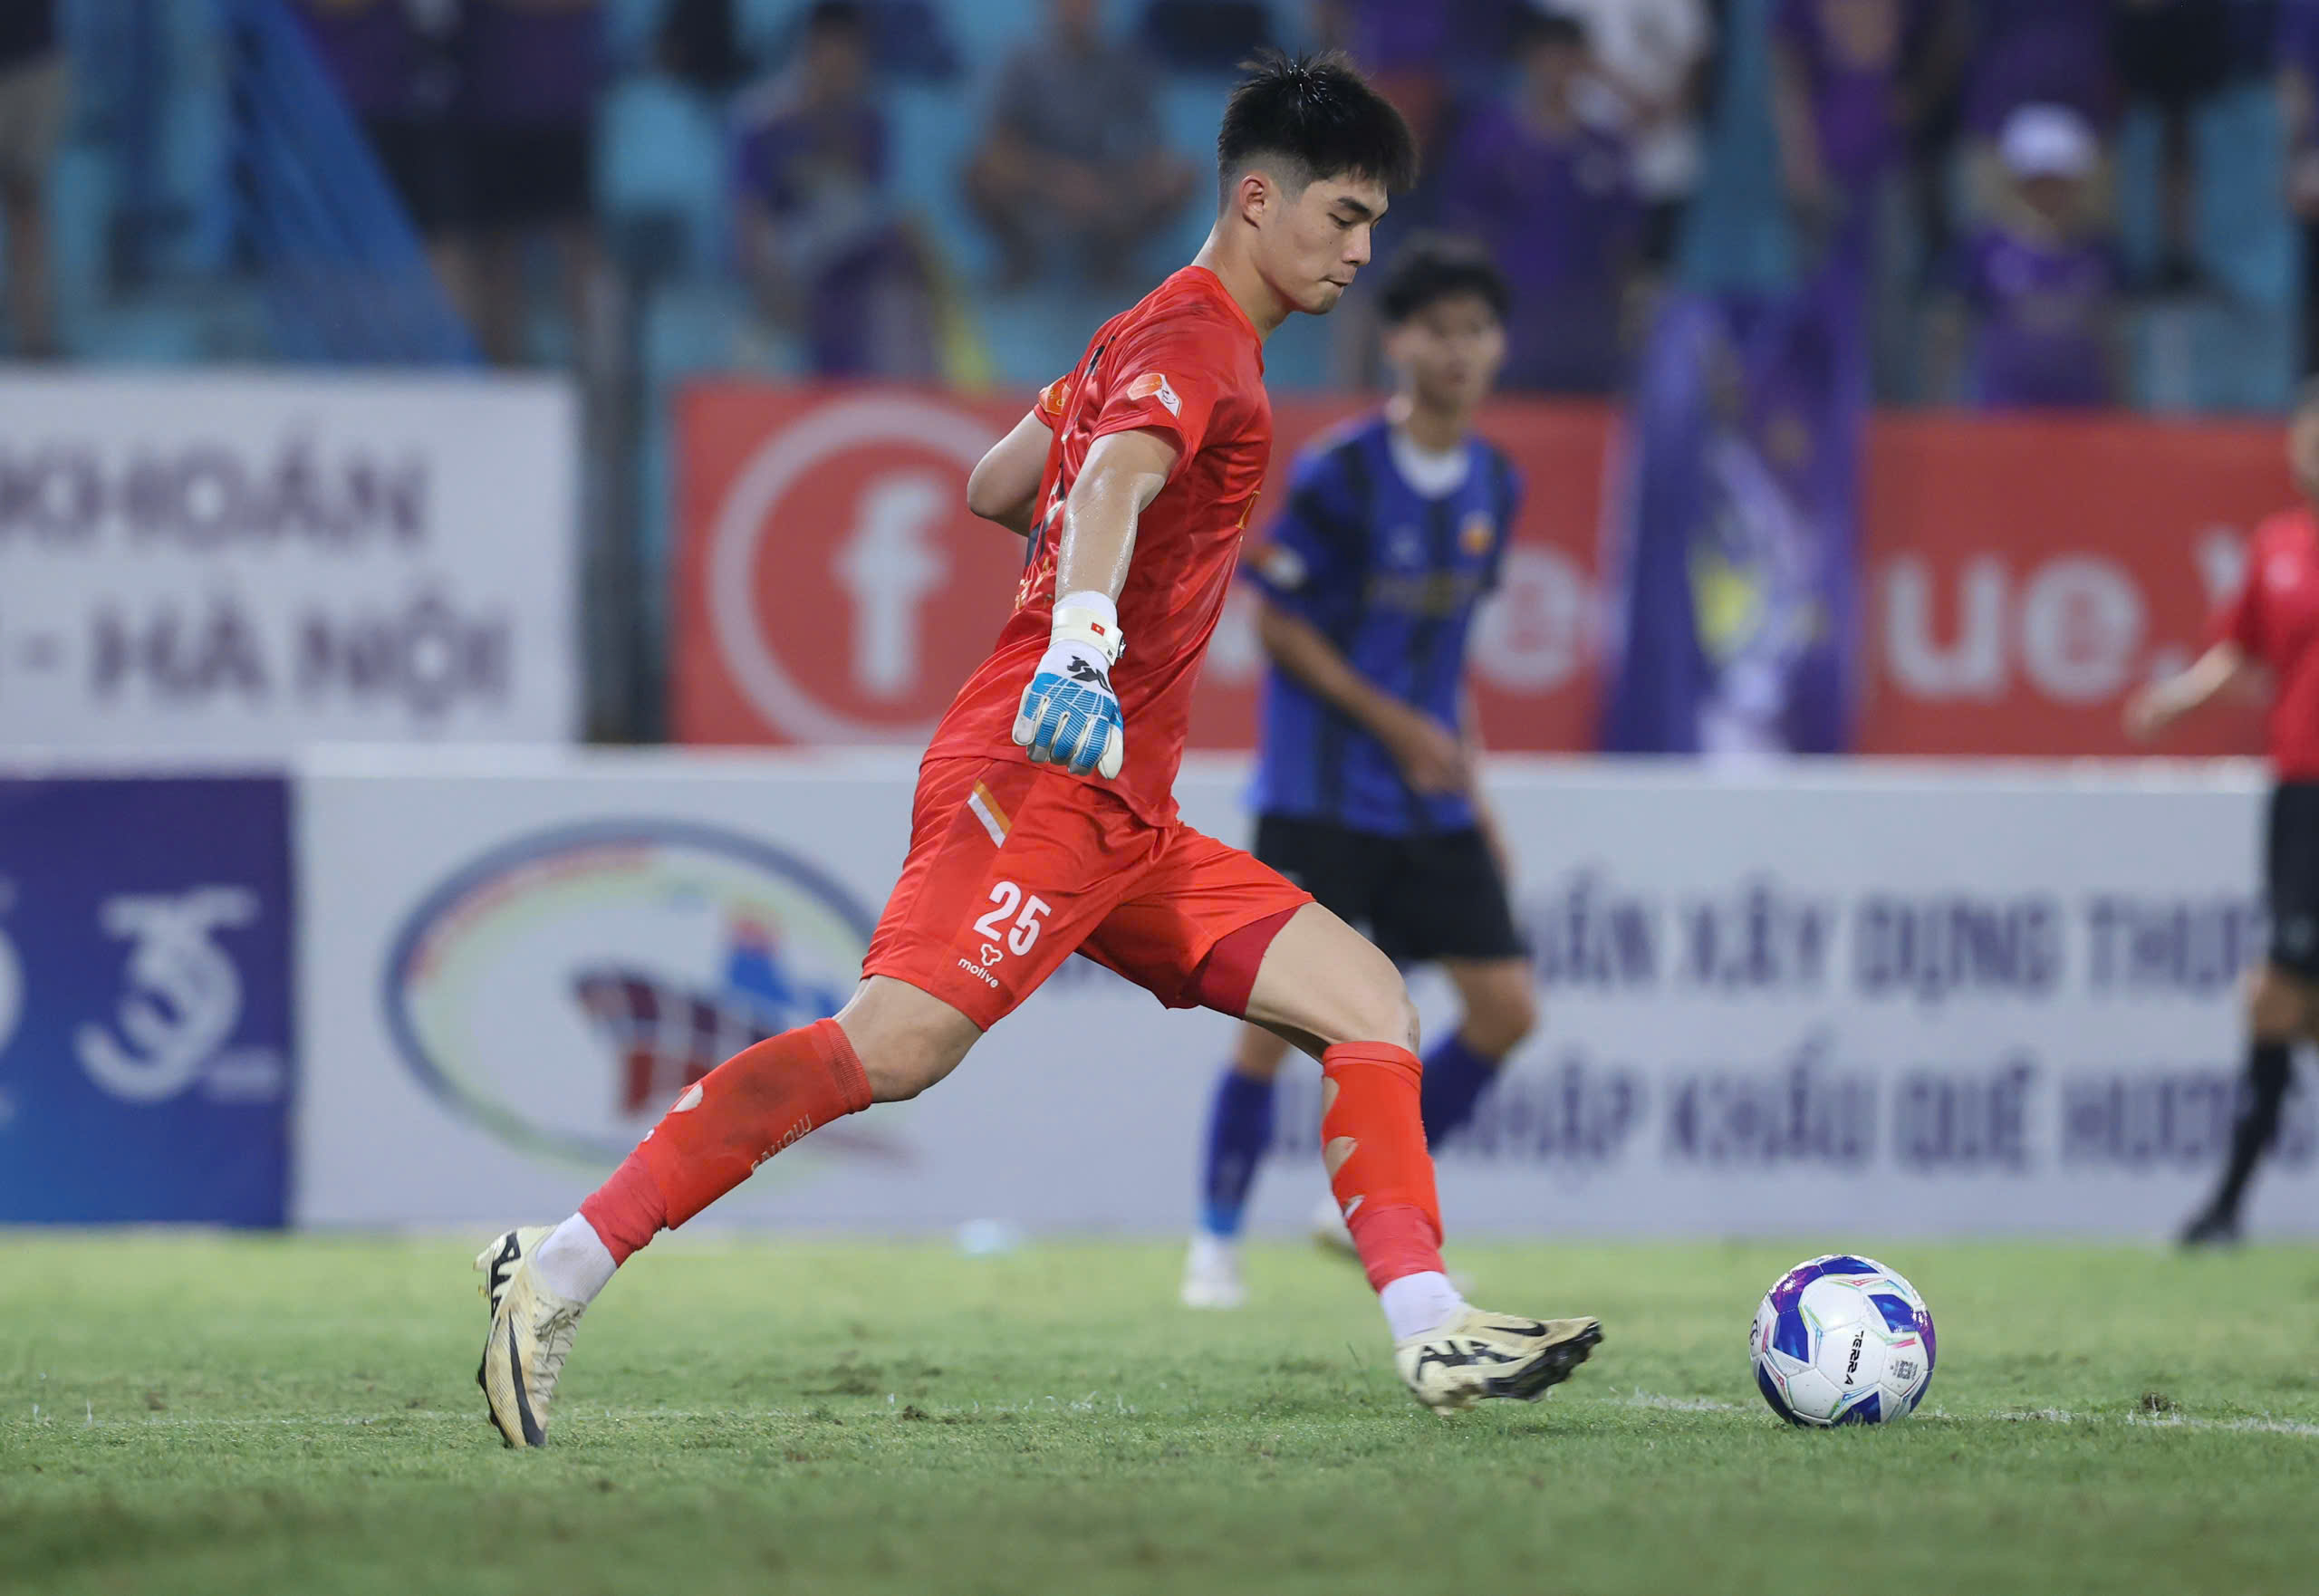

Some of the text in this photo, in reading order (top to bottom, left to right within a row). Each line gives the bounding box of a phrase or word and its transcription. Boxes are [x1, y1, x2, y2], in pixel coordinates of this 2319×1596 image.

[973, 880, 1052, 957] 25
[957, 957, 999, 988] motive
[1843, 1329, 1865, 1387] TERRA
